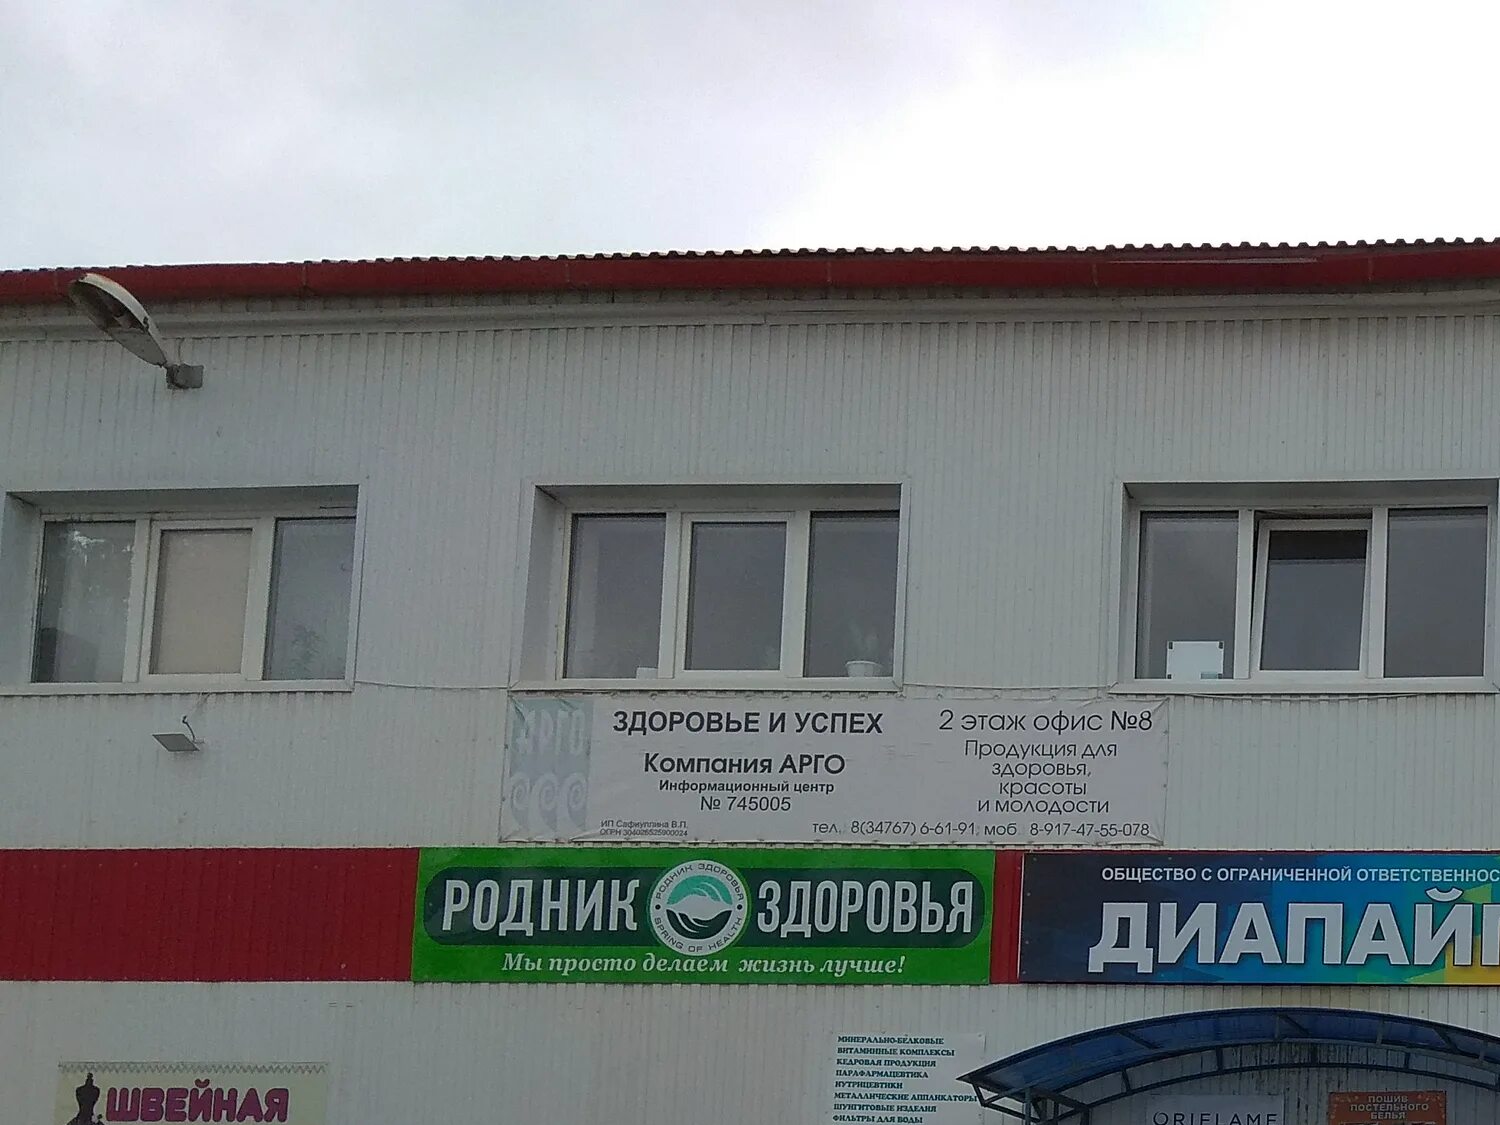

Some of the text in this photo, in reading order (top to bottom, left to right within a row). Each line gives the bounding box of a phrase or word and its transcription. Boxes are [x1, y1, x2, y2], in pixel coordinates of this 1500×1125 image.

[613, 711, 883, 735] ЗДОРОВЬЕ И УСПЕХ
[939, 710, 1152, 735] 2 этаж офис №8
[965, 740, 1117, 759] Продукция для
[644, 753, 845, 774] Компания АРГО
[992, 762, 1091, 778] здоровья,
[659, 779, 834, 795] Информационный центр
[999, 781, 1086, 797] красоты
[727, 796, 791, 811] 745005
[978, 801, 1109, 815] и молодости
[656, 863, 744, 900] РОДНИК ЗДОРОВЬЯ
[1102, 867, 1195, 884] ОБЩЕСТВО
[1201, 868, 1211, 882] С
[1217, 863, 1352, 883] ОГРАНИЧЕННОЙ
[442, 879, 973, 938] РОДНИК ЗДОРОВЬЯ
[655, 917, 683, 949] SPRING
[708, 917, 742, 950] HEALTH
[502, 953, 905, 977] Мы просто делаем жизнь лучше!
[836, 1058, 882, 1066] КЕДРОВАЯ
[106, 1078, 289, 1122] ШВЕЙНАЯ
[1350, 1103, 1429, 1112] ПОСТЕЛЬНОГО
[1371, 1112, 1405, 1120] БЕЛЬЯ
